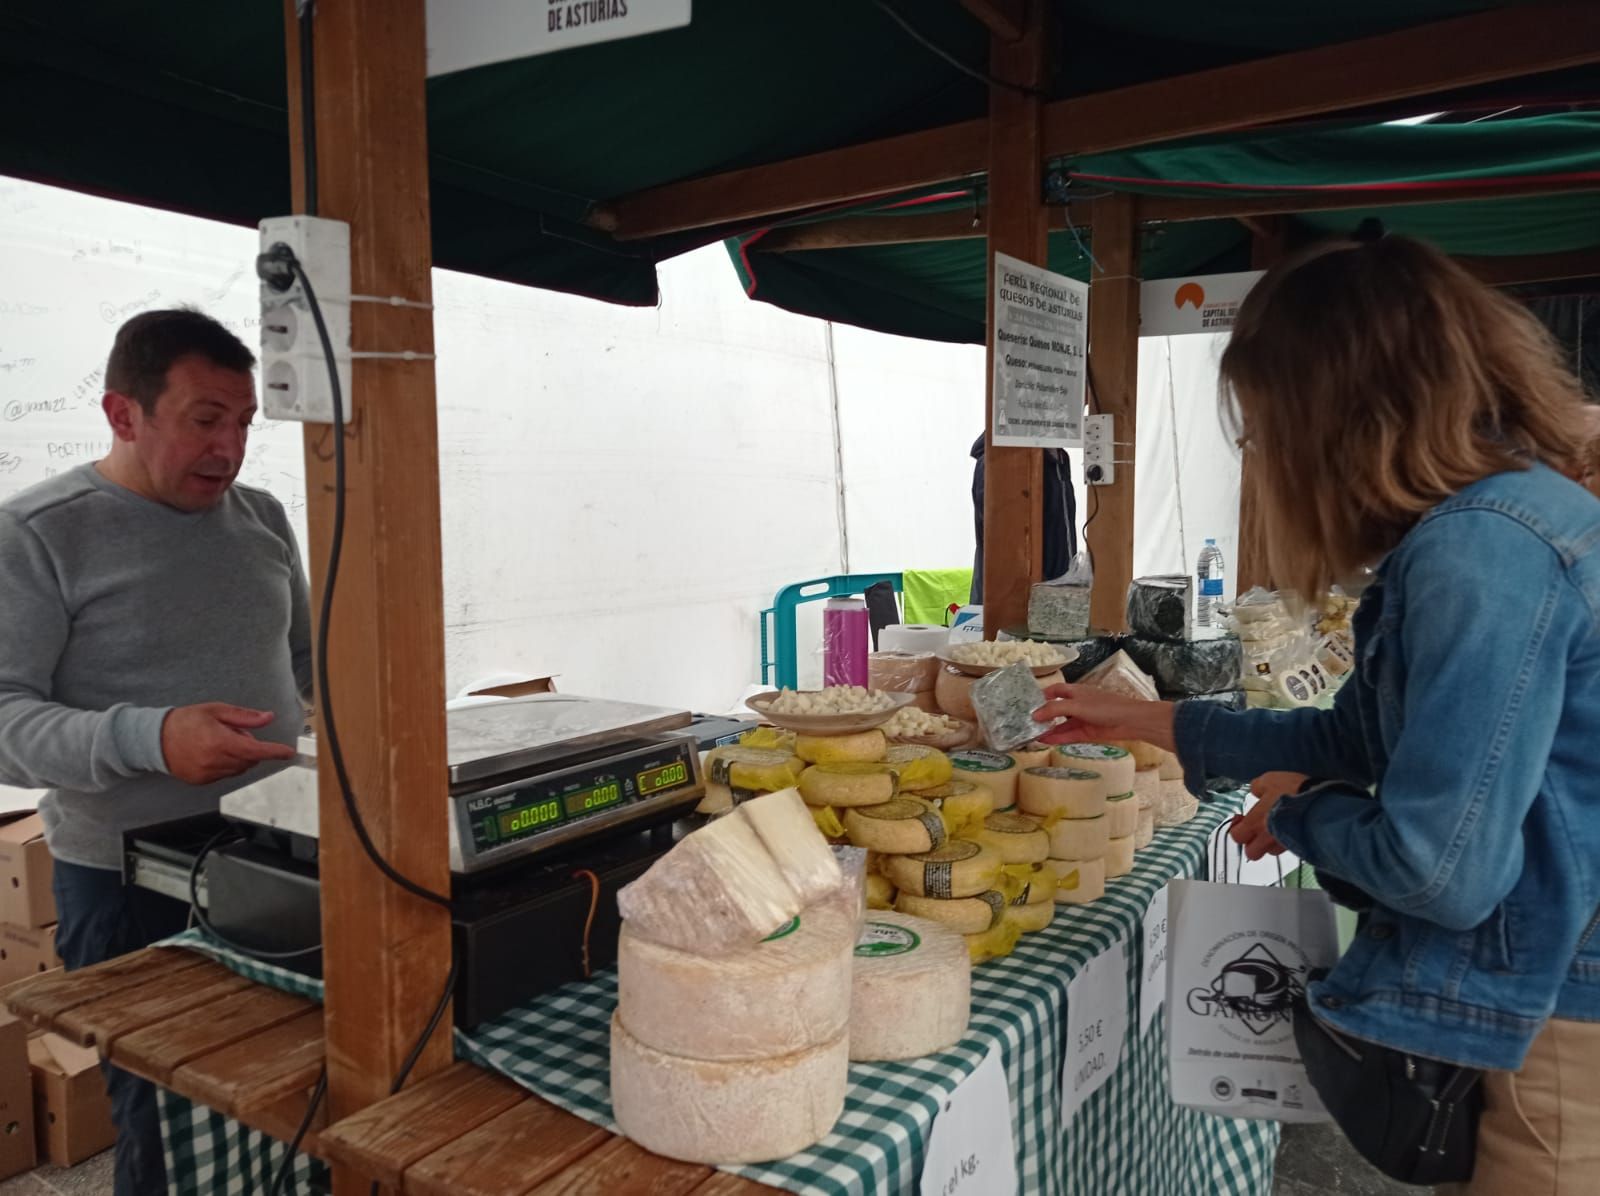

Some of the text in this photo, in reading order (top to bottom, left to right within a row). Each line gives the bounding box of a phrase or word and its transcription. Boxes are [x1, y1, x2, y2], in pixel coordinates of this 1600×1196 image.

[548, 0, 627, 32] DE ASTURIAS
[1000, 288, 1034, 307] QUESOS
[1036, 297, 1047, 311] DE
[1048, 303, 1083, 321] ASTURIAS
[1030, 281, 1067, 303] REGIONAL
[1096, 1019, 1103, 1037] €
[949, 1167, 959, 1194] el
